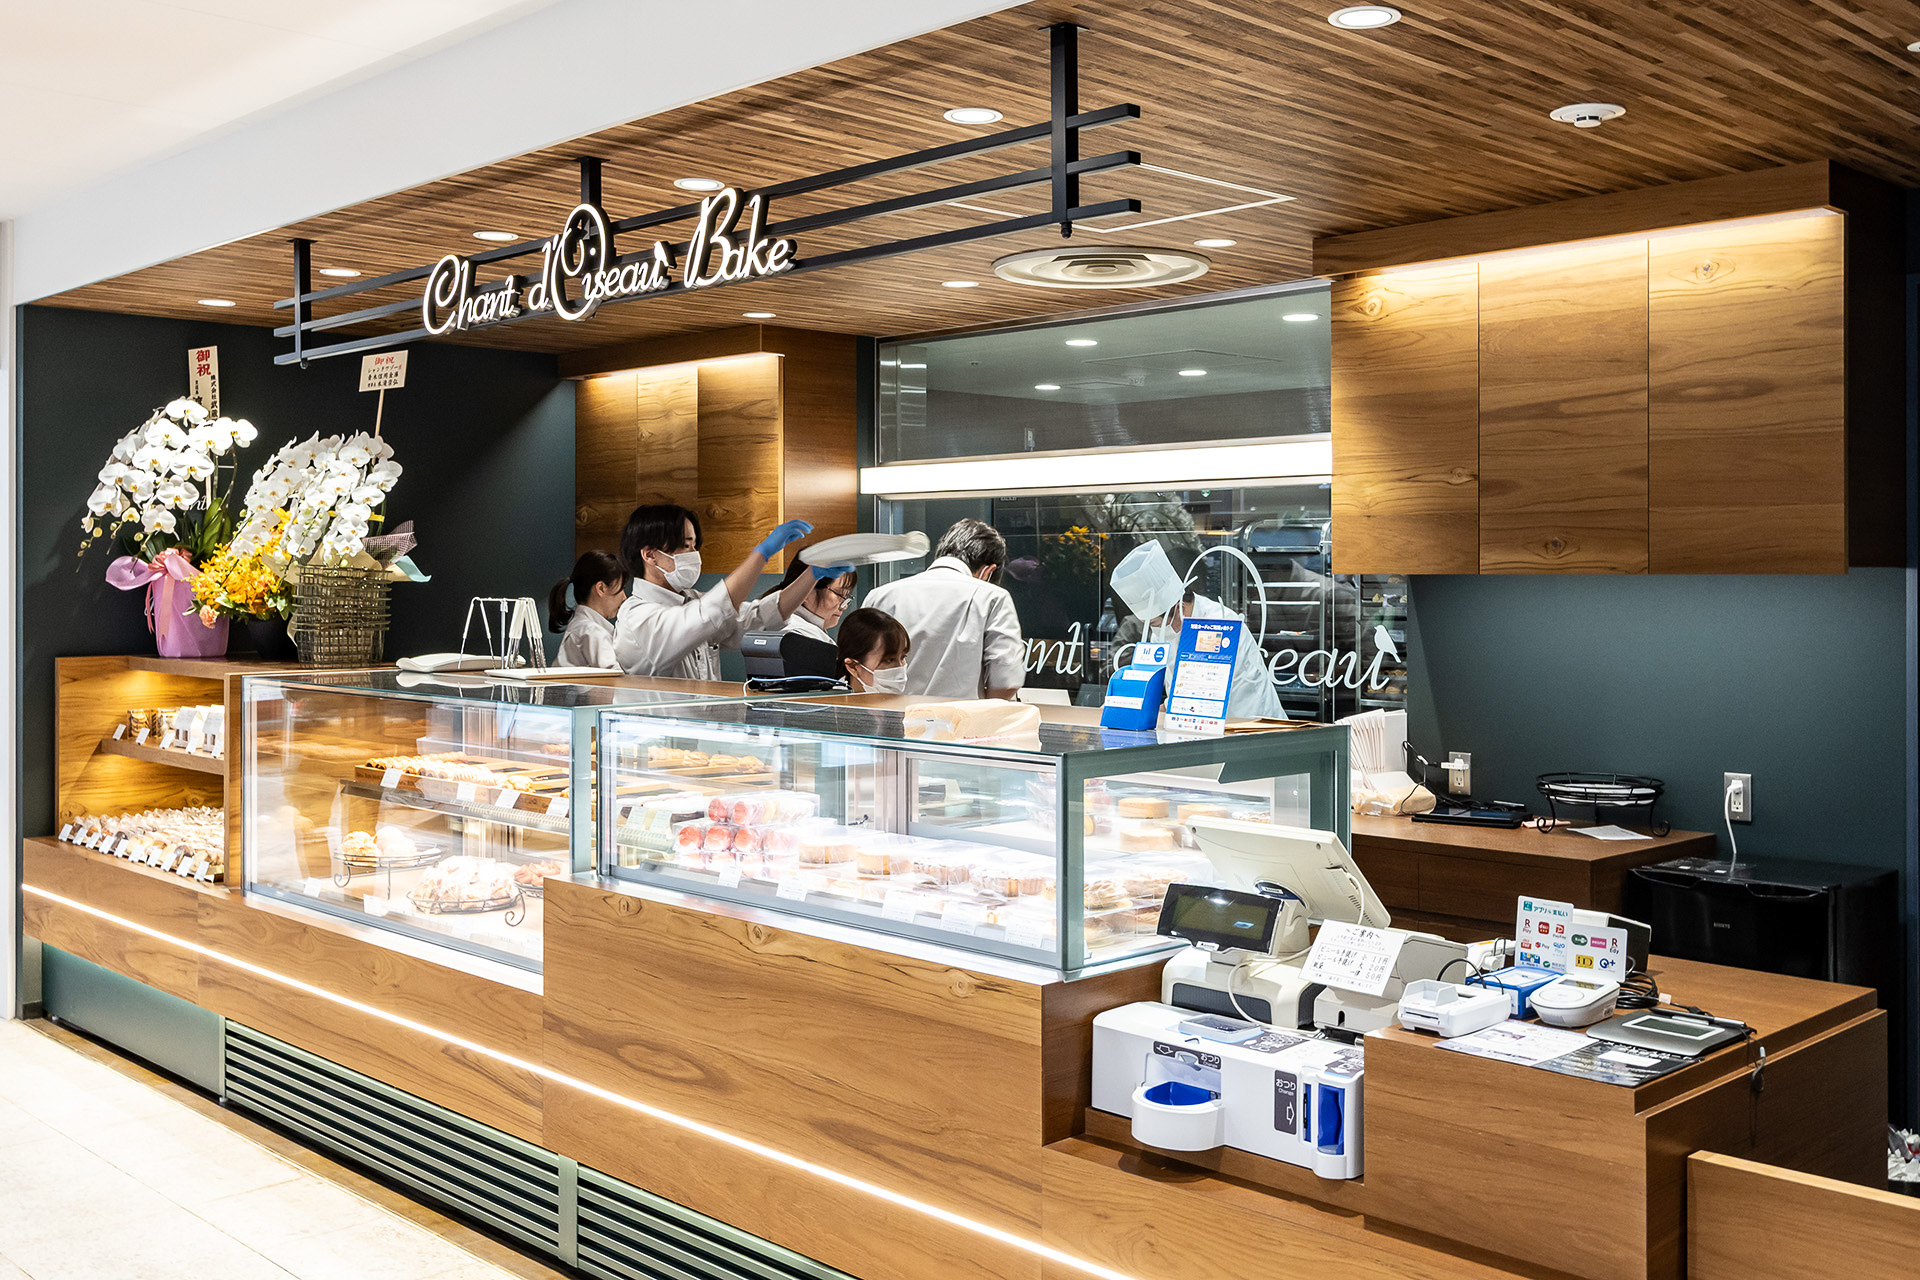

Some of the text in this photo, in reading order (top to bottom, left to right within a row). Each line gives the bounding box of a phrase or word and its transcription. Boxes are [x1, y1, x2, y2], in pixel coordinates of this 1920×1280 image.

[423, 254, 518, 335] Chant
[684, 187, 791, 289] Bake
[196, 350, 211, 377] 御祝
[1201, 1053, 1220, 1064] おつり
[1276, 1079, 1296, 1091] おつり
